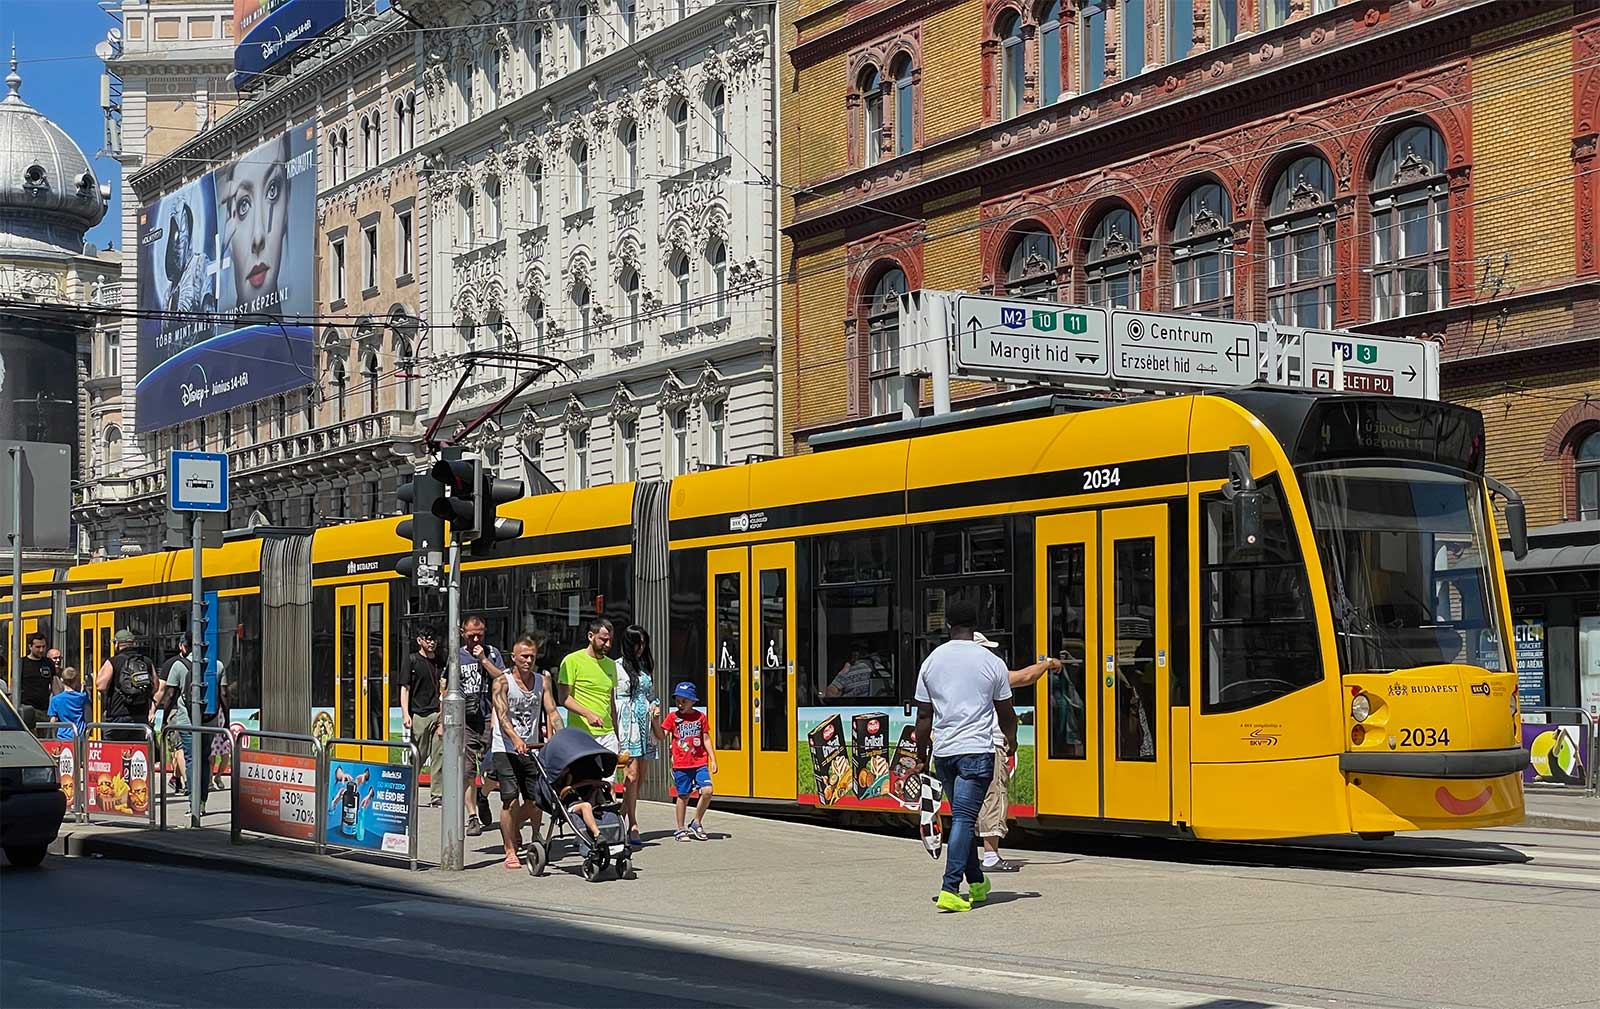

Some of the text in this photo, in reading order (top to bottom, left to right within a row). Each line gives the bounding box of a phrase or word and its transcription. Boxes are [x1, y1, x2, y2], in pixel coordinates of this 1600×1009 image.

[667, 180, 724, 213] NATIONAL
[617, 211, 639, 231] HOTEL
[156, 332, 172, 348] TÖBB
[175, 324, 191, 341] MINT
[251, 288, 288, 312] KÉPZELNI
[1004, 309, 1023, 326] M2
[1039, 313, 1051, 328] 10
[1070, 316, 1081, 331] 11
[1150, 324, 1213, 345] Centrum
[990, 341, 1040, 363] Margit
[1363, 347, 1371, 360] 3
[212, 379, 230, 396] Június
[231, 371, 249, 390] 14-től
[1343, 375, 1391, 392] ELETI PU.
[1082, 468, 1121, 491] 2034
[356, 562, 379, 571] BUDAPEST
[1411, 685, 1459, 693] BUDAPEST
[1400, 728, 1450, 747] 2034
[88, 749, 102, 760] KFC
[248, 765, 303, 783] ZÁLOGHÁZ
[281, 791, 303, 806] -30%
[376, 790, 385, 800] NE
[397, 792, 405, 802] BE
[372, 800, 409, 814] KEVESEBBEL!
[291, 808, 315, 824] -70%
